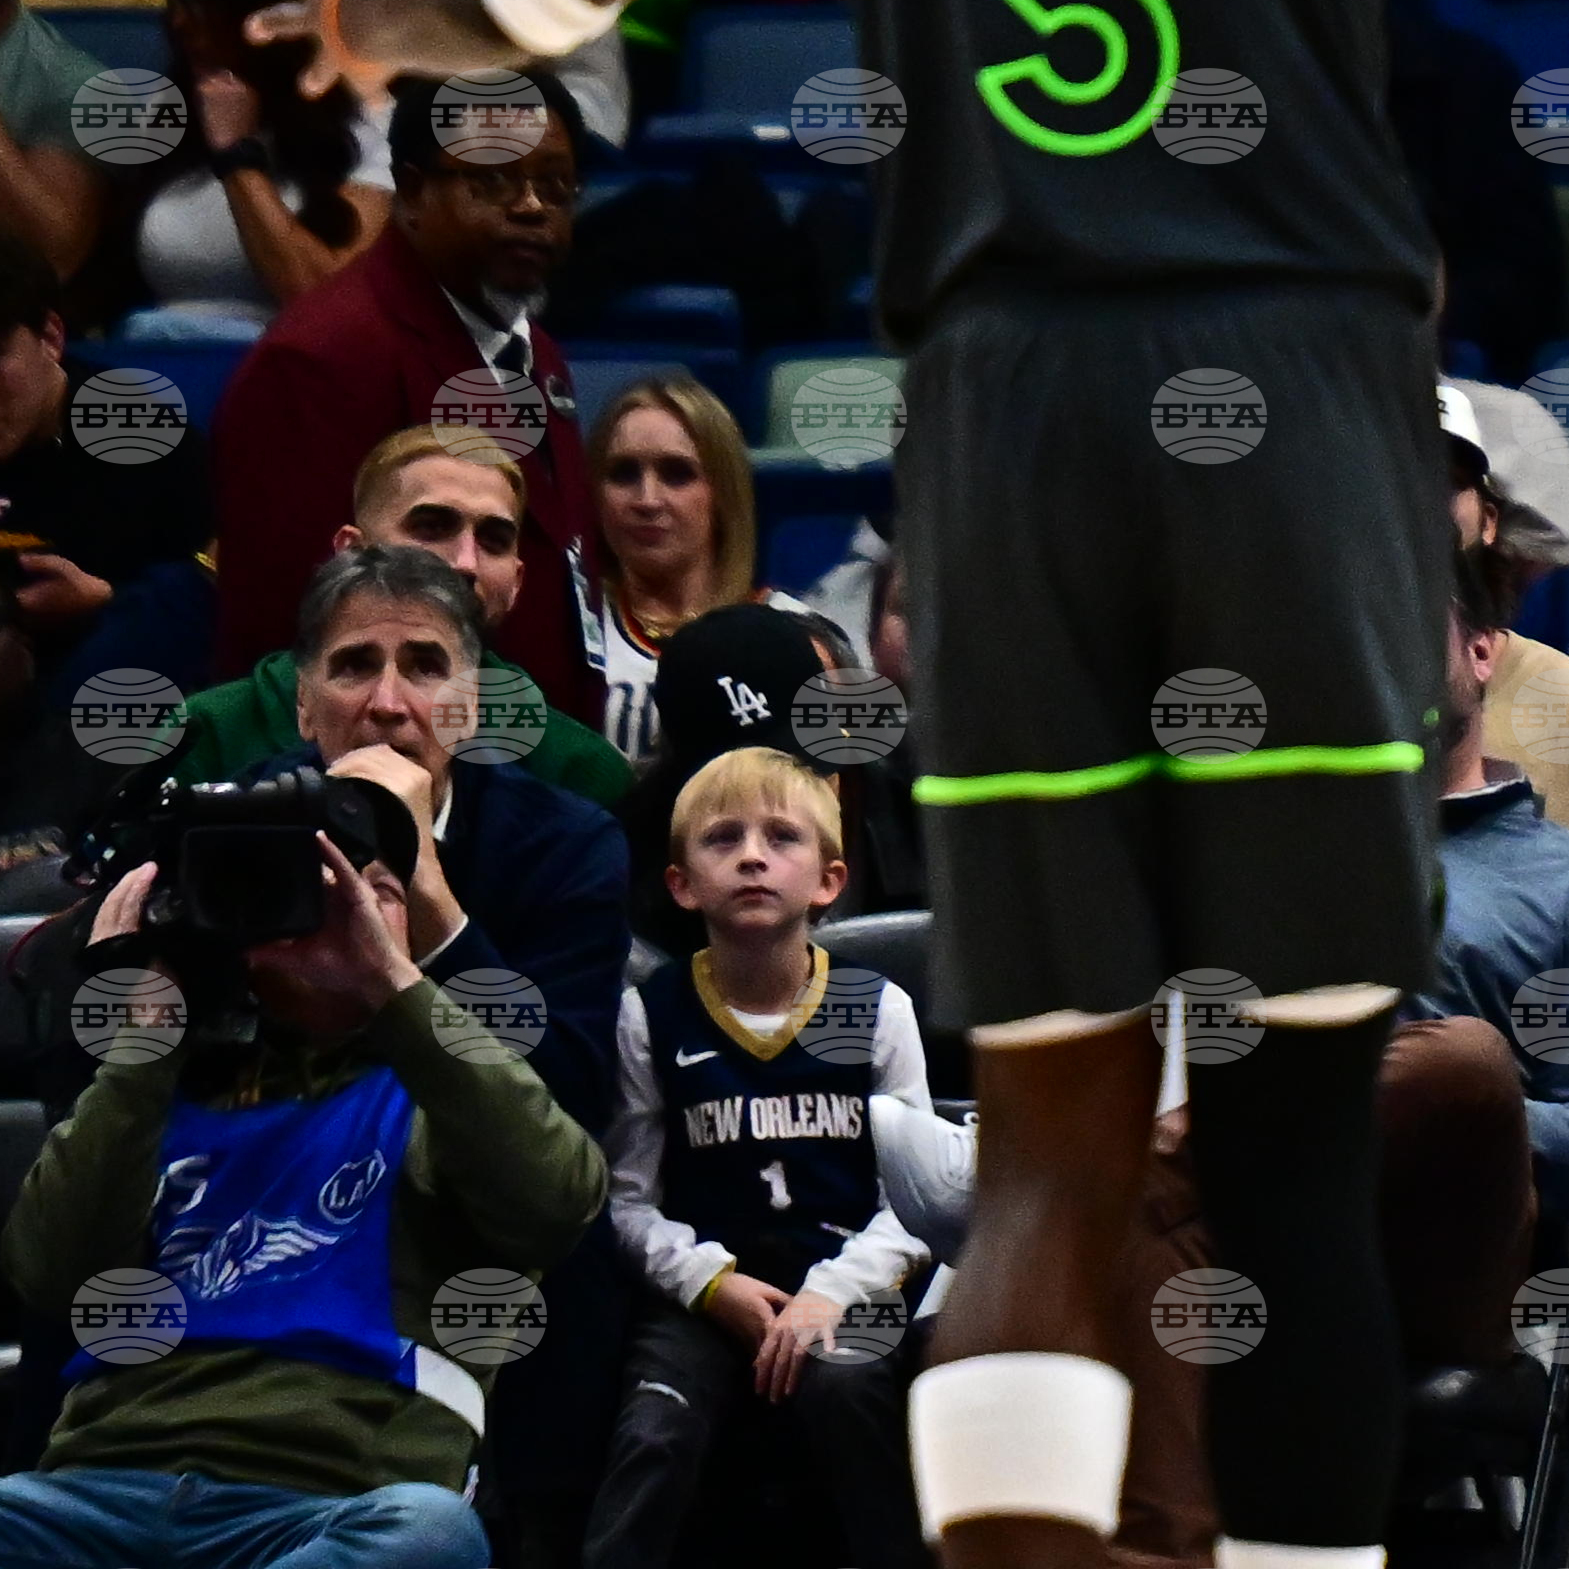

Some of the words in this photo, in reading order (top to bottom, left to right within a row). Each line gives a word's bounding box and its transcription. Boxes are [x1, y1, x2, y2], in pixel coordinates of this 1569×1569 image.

[717, 675, 772, 727] LA
[684, 1093, 743, 1148] NEW
[749, 1092, 864, 1141] ORLEANS
[759, 1160, 793, 1210] 1
